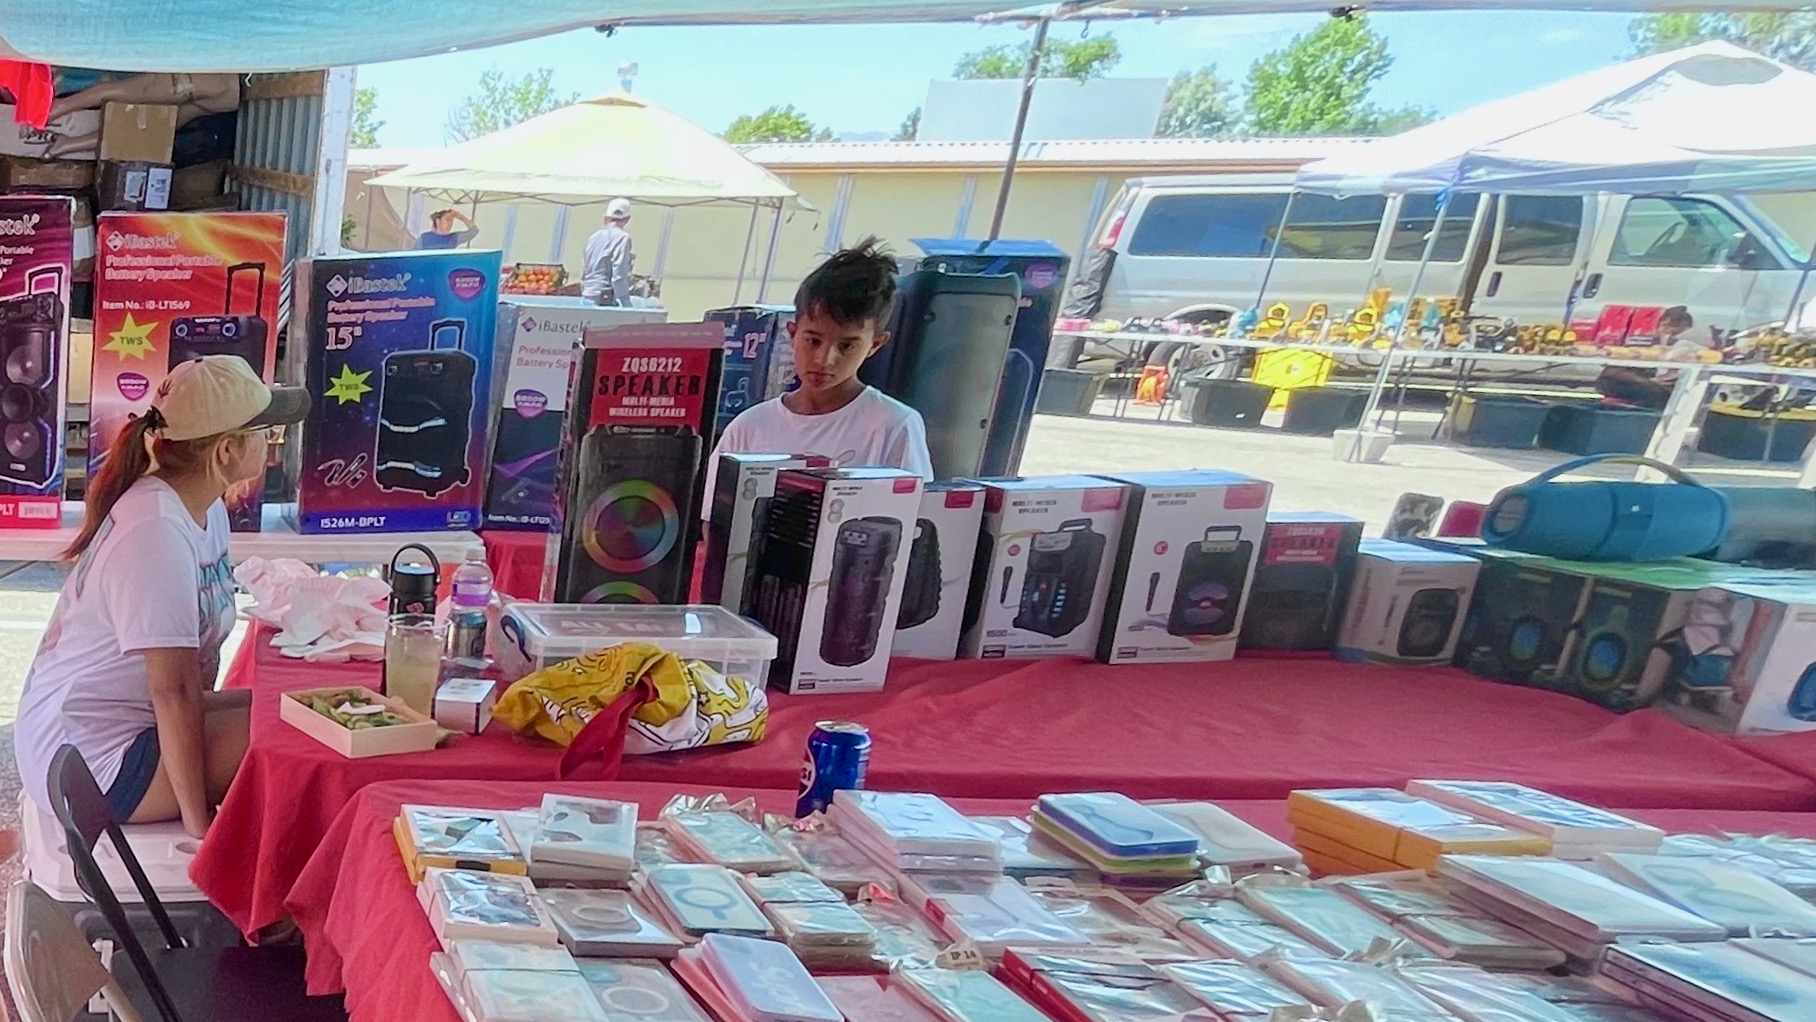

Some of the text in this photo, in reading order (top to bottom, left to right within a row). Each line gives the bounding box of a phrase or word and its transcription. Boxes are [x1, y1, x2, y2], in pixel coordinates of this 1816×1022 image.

[0, 246, 34, 255] Portable
[102, 301, 124, 310] Item
[120, 336, 143, 346] TWS
[518, 345, 572, 356] Profession
[598, 374, 701, 396] SPEAKER
